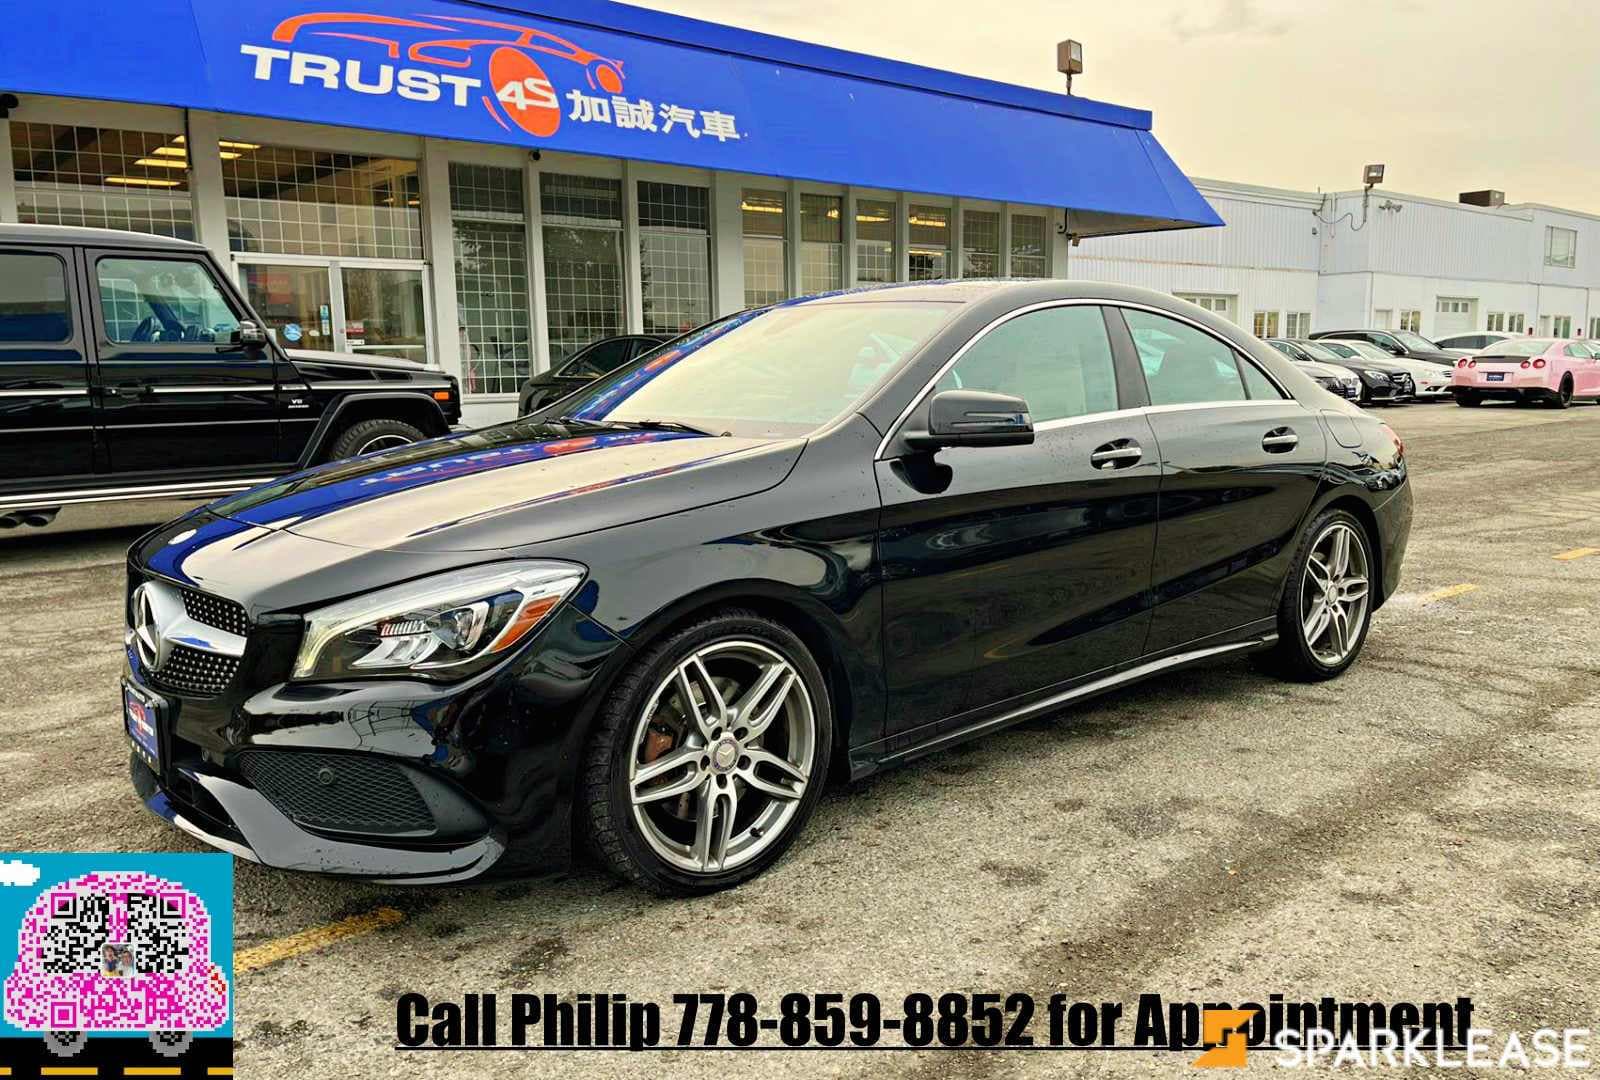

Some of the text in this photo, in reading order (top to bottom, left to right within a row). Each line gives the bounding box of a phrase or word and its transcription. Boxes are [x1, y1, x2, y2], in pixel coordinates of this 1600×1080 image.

[240, 44, 740, 142] TRUST 4S 加誠汽車
